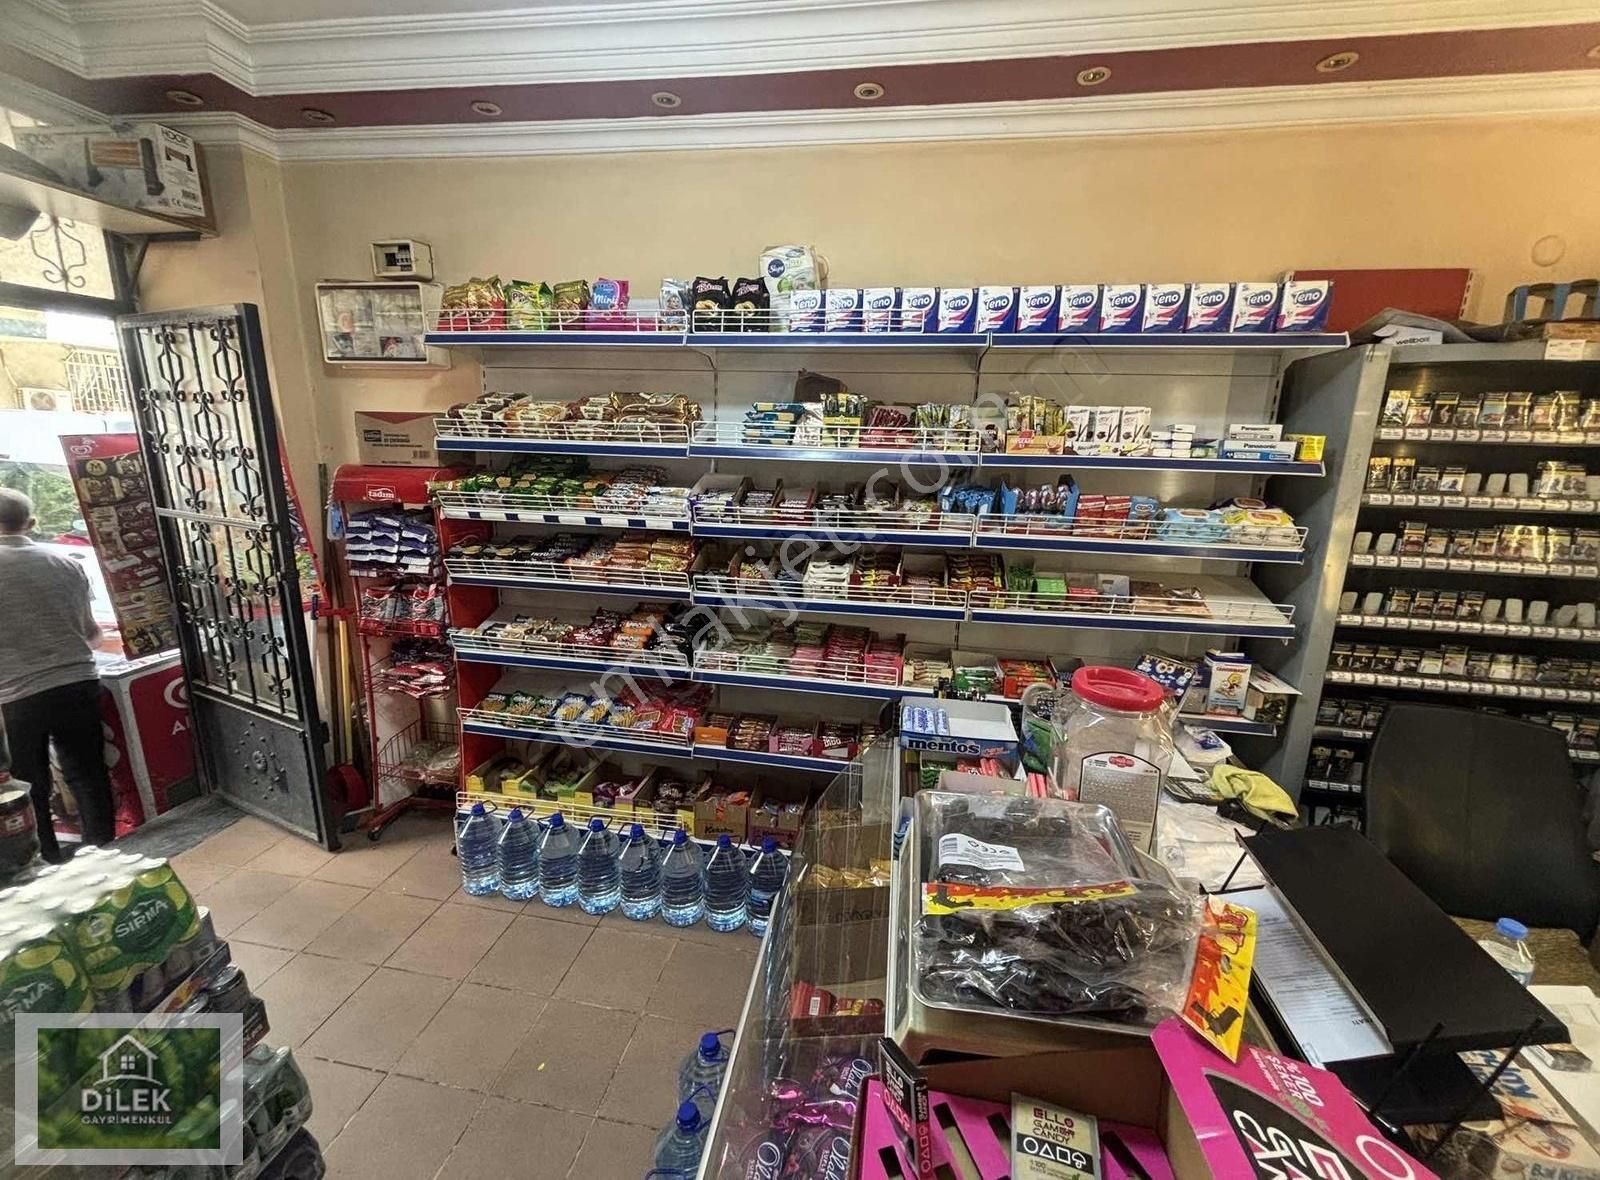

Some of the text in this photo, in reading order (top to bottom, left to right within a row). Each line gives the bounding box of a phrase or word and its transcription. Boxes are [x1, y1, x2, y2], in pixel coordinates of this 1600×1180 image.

[868, 296, 891, 309] Teno
[907, 295, 930, 308] Teno
[945, 297, 968, 309] Teno
[984, 297, 1008, 310] Teno
[1025, 295, 1050, 308] Teno
[1067, 295, 1092, 308] Teno
[1110, 294, 1135, 308] Teno
[1152, 292, 1179, 305] Teno
[1197, 292, 1223, 305] Teno
[1244, 293, 1271, 305] Teno
[1291, 292, 1320, 305] Teno
[908, 739, 980, 755] mentos
[115, 900, 169, 938] SIRMA
[1033, 1107, 1074, 1128] ELLO
[1033, 1128, 1070, 1144] CANDY
